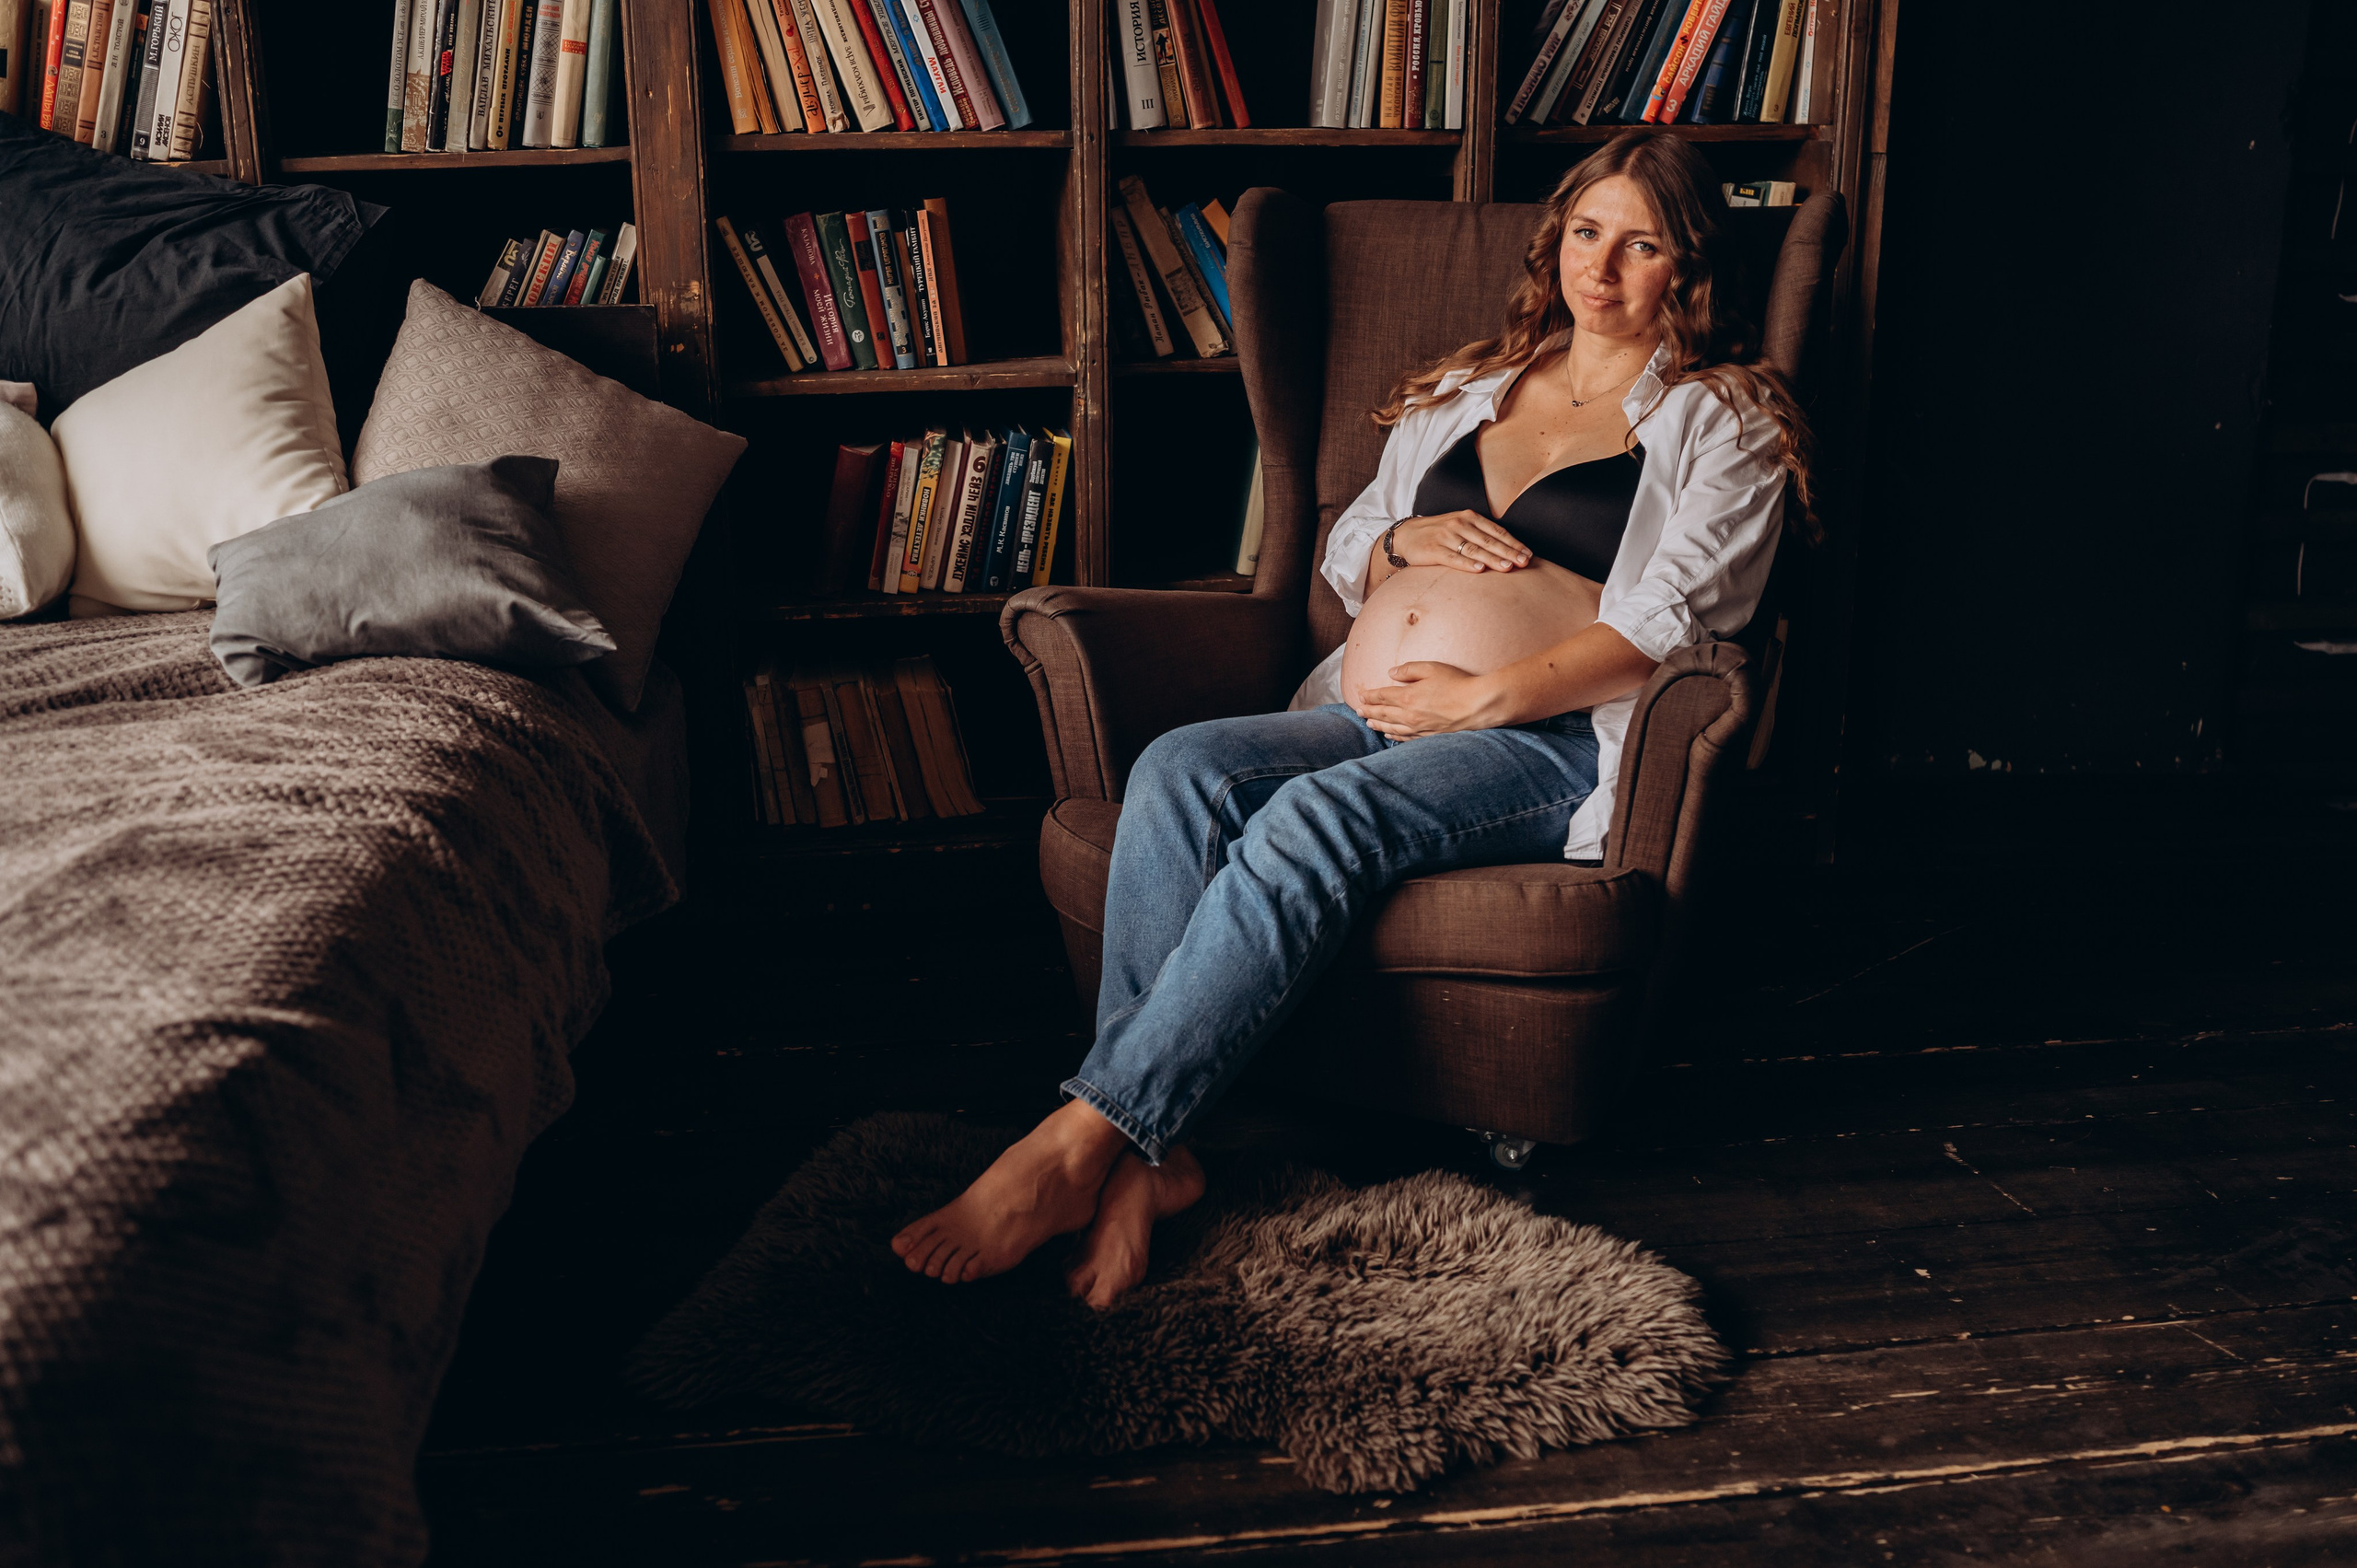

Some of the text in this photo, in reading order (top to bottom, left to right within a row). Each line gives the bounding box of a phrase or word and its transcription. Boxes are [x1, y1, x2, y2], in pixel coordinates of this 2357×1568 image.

[114, 17, 124, 51] ТОЛСТОЙ
[148, 5, 164, 62] М.ГОРЬКИЙ
[167, 11, 182, 52] ОЖОГ
[397, 29, 405, 45] УСЕ
[522, 6, 533, 52] МЮНХЕН
[1130, 1, 1146, 62] ИСТОРИЯ
[1603, 11, 1617, 28] ВЕК
[1616, 16, 1632, 45] СЦЕНАРИИ
[1783, 3, 1795, 36] ЕВГЕНИЙ
[1807, 10, 1816, 37] Остров
[393, 46, 403, 84] ЗОЛОТОМ
[725, 36, 735, 64] сердца
[1387, 19, 1405, 71] ВОДИТЕЛИ
[1662, 44, 1686, 85] САМСОН
[1678, 29, 1712, 87] АРКАДИЙ
[498, 92, 506, 123] ПЕРВЫХ
[502, 48, 510, 90] ПРОТАЛИН
[731, 65, 742, 99] Болезни
[844, 45, 870, 105] ЗАРЯ КОЛХИДЫ
[896, 58, 916, 98] ПОТИЕВСКИЙ
[927, 56, 946, 95] МАУГЛИ
[1509, 31, 1562, 119] Я ПОЗНАЮ МИР
[1585, 79, 1603, 110] ТОРЖЕСТВ
[477, 75, 489, 118] ВАЦЛАВ
[912, 99, 925, 121] ВИКТОР
[1384, 75, 1394, 118] НИКОЛАЙ
[1392, 75, 1402, 118] ЧУКОВСКИЙ
[1666, 99, 1678, 113] 3
[155, 113, 165, 145] ВАСИЛИЙ
[800, 227, 816, 265] КАЗАНОВА
[1190, 212, 1211, 250] БИОХИМИЯ
[524, 240, 558, 307] ОВСКИЙ
[603, 255, 621, 291] МИЛОСЕРДИЯ
[731, 245, 756, 288] БАТЮШКЕ
[877, 230, 895, 285] МИРЗА ИБРАГИМОВ
[842, 266, 856, 308] Геннадий
[910, 226, 933, 339] Борис Акунин ТУРЕЦКИЙ ГАМБИТ
[1137, 279, 1154, 309] Рыбак
[758, 299, 782, 339] СОВЕТОМ
[820, 315, 834, 346] жизни
[822, 293, 840, 333] История
[933, 311, 944, 354] АНГЛИЙСКИЙ
[1149, 312, 1165, 343] Натан
[780, 341, 789, 353] ЗА
[886, 457, 897, 498] ОТКРЫТИЕ
[891, 467, 900, 490] МИРА
[910, 488, 931, 563] НОВИНКИ ДЕТЕКТИВА
[952, 476, 982, 582] ДЖЕЙМС ХЭДЛИ ЧЕЙЗ
[995, 505, 1011, 554] М.К. Касвинов
[1039, 492, 1057, 572] КАК НАЗВАТЬ РЕБЕНКА
[927, 555, 937, 581] КАРУСЕЛЬ
